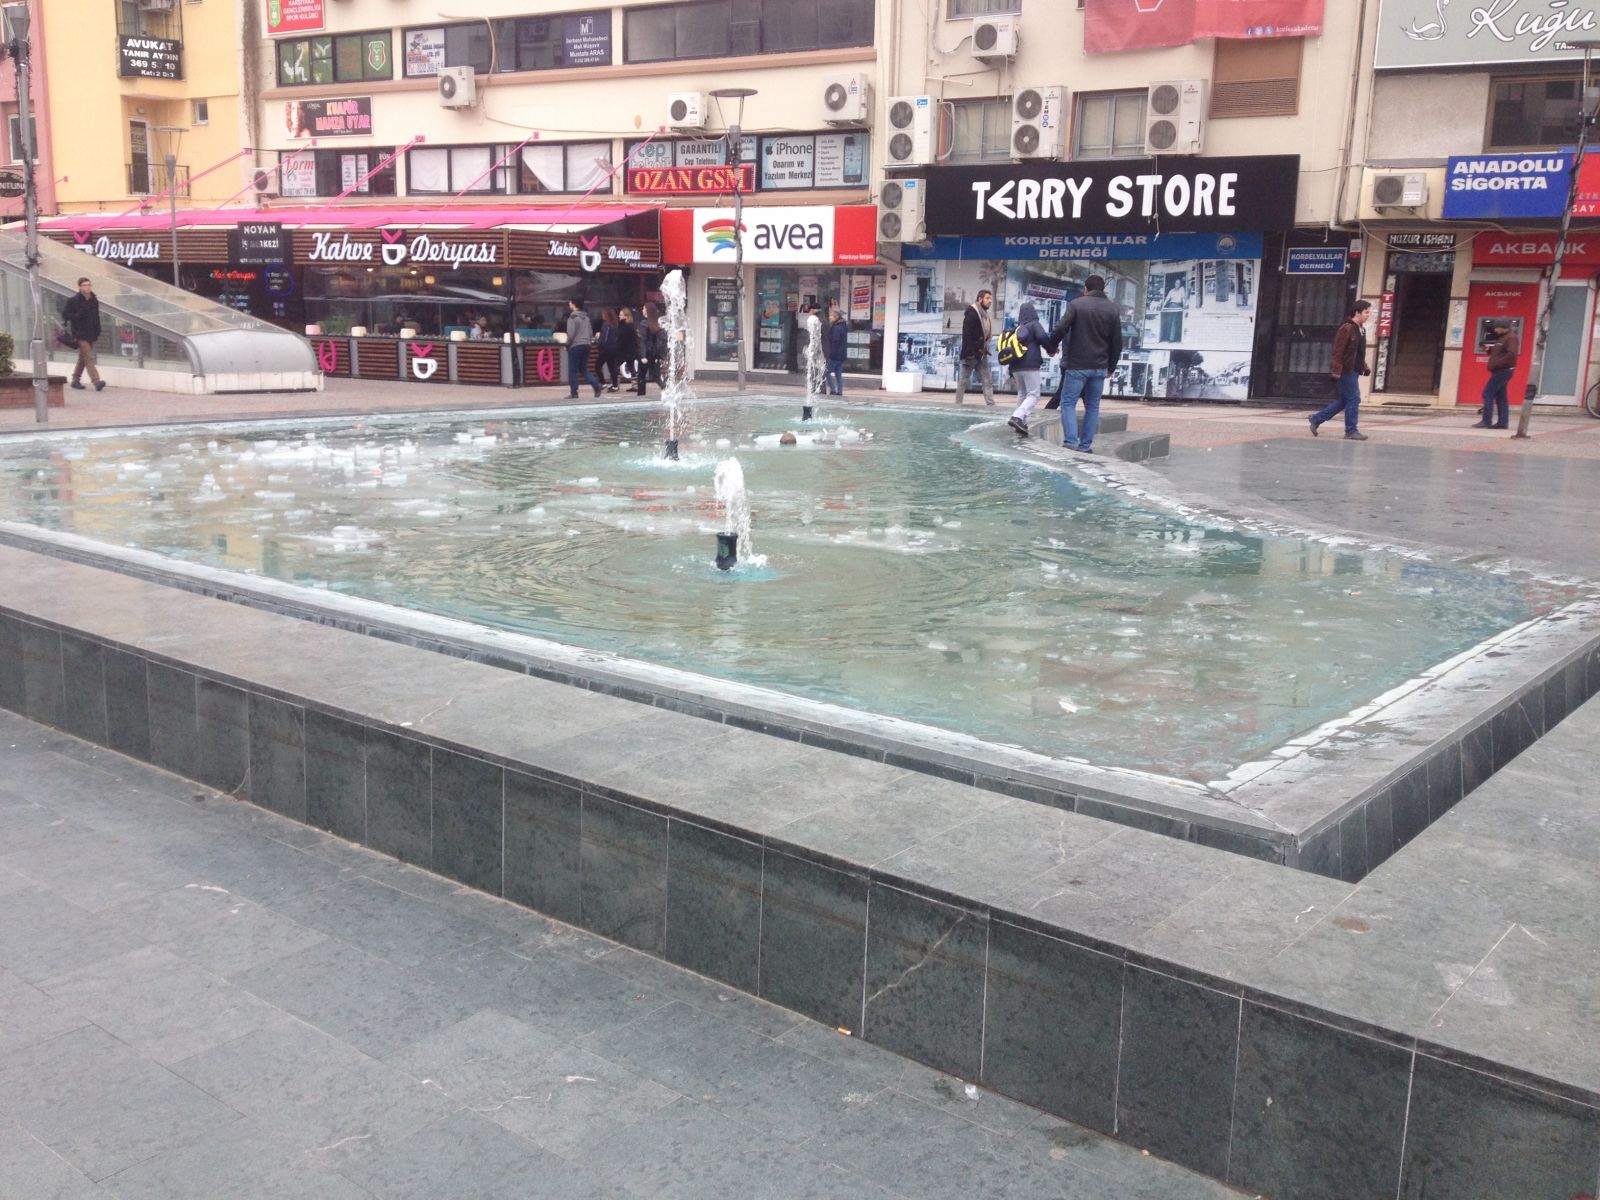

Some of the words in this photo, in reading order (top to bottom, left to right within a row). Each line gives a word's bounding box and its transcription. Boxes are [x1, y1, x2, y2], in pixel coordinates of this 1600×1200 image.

[126, 38, 174, 51] AVUKAT
[130, 59, 148, 68] 369
[346, 114, 370, 129] UYAR
[776, 142, 813, 155] iPhone
[684, 158, 694, 166] Cep
[1453, 159, 1564, 174] ANADOLU
[635, 170, 692, 190] OZAN
[698, 169, 745, 189] GSM
[765, 171, 786, 180] Yazılım
[788, 170, 813, 179] Merkezi
[1451, 174, 1548, 191] SİGORTA
[972, 177, 1093, 220] TERRY
[1105, 173, 1238, 217] STORE
[243, 225, 276, 234] NOYAN
[754, 222, 823, 250] avea
[1005, 235, 1148, 246] KORDELYALILAR
[1389, 234, 1420, 244] HUZUR
[95, 236, 160, 266] Deryası
[309, 233, 373, 260] Kahve
[410, 235, 497, 269] Deryası
[548, 240, 578, 256] Kahve
[608, 246, 641, 263] Deryası
[1039, 247, 1108, 258] DERNEĞİ
